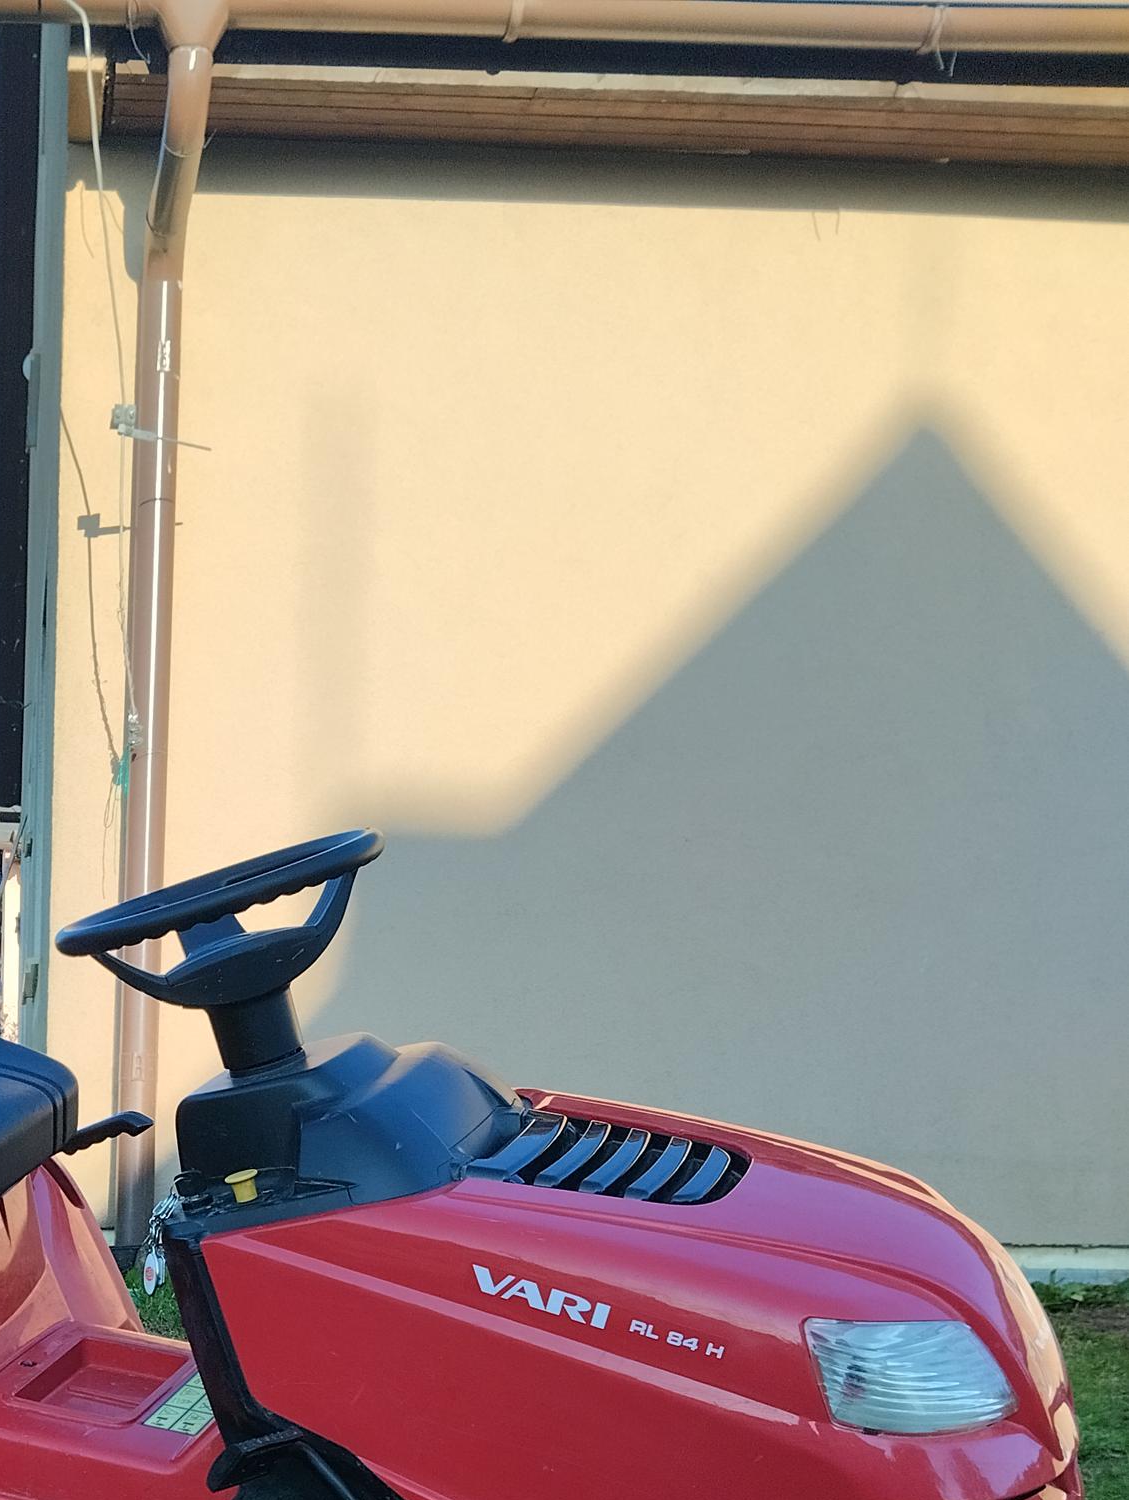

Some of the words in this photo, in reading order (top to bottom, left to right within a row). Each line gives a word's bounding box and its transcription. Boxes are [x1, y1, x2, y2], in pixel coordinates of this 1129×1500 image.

[472, 1263, 612, 1330] VARI
[629, 1319, 659, 1340] RL
[666, 1331, 699, 1351] 84
[705, 1342, 725, 1359] H
